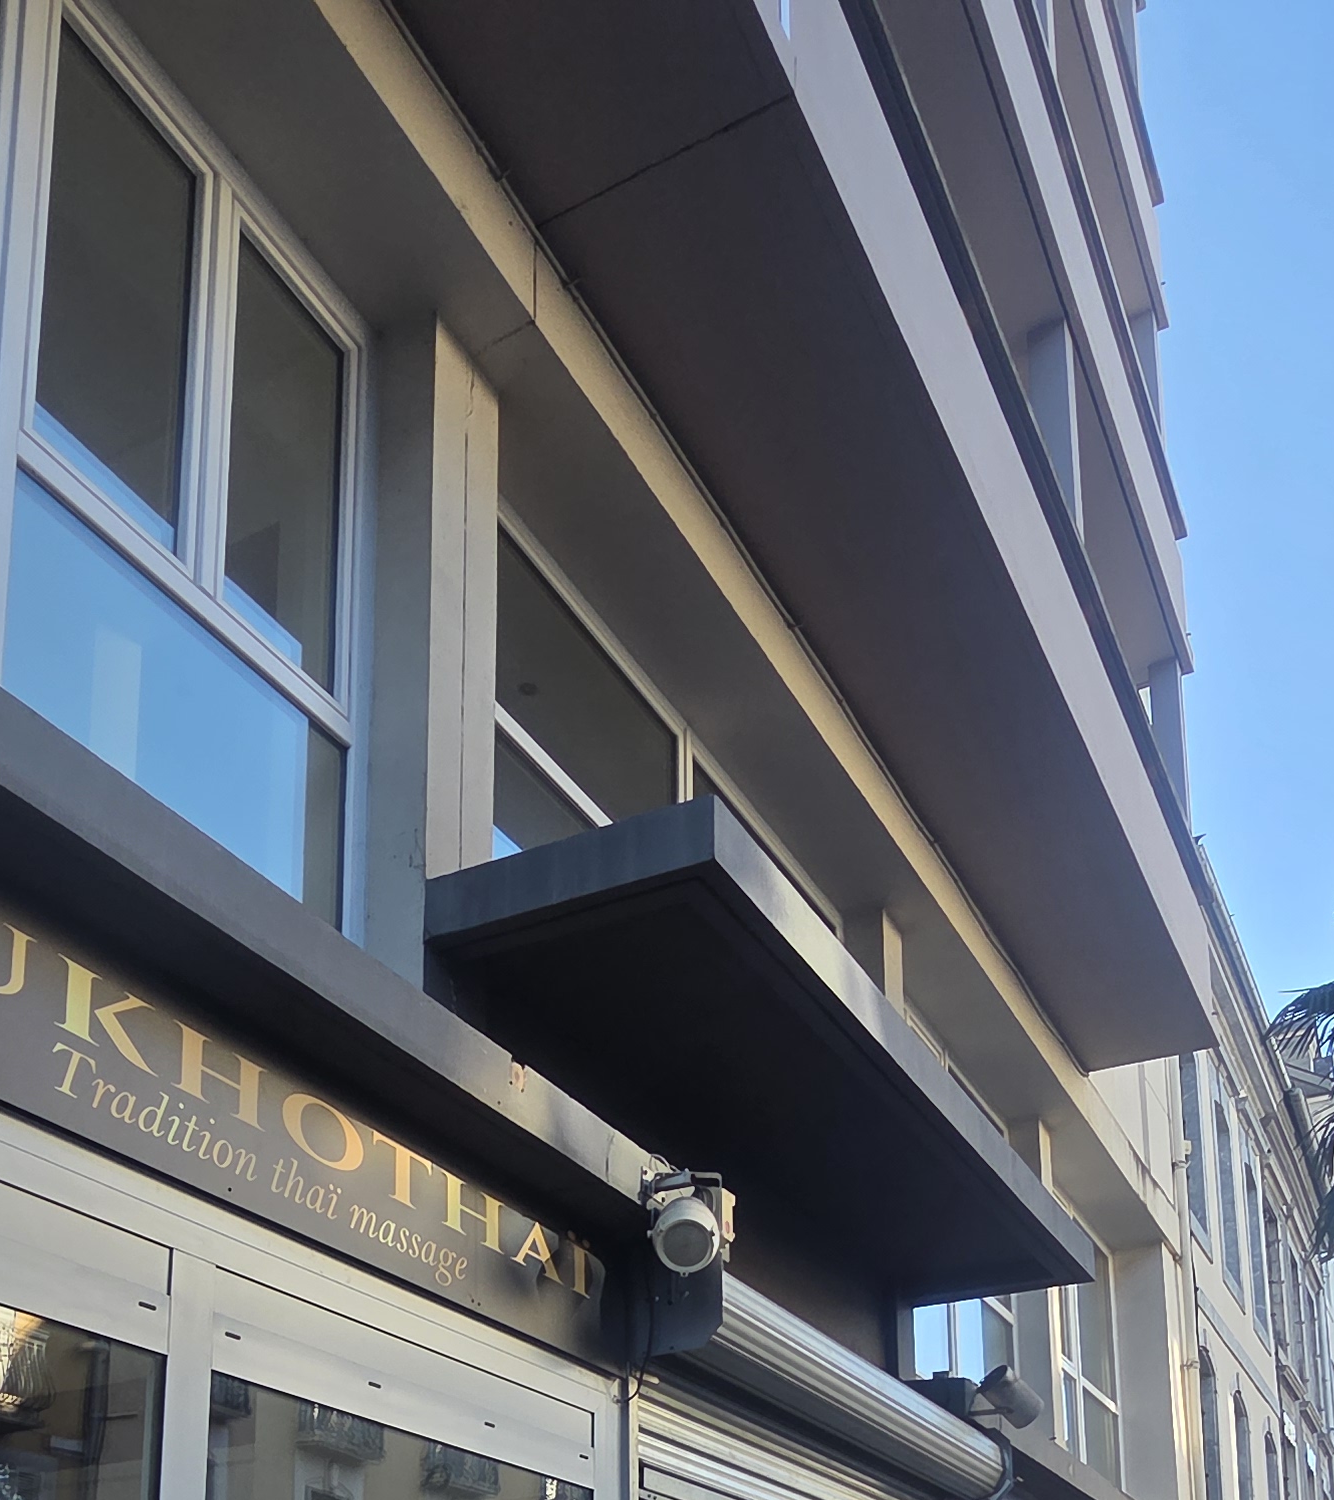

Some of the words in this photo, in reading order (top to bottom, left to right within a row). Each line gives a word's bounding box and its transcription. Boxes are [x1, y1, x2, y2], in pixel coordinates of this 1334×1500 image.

[52, 1042, 258, 1182] Tradition
[271, 1157, 339, 1222] thaï
[350, 1204, 468, 1287] massage
